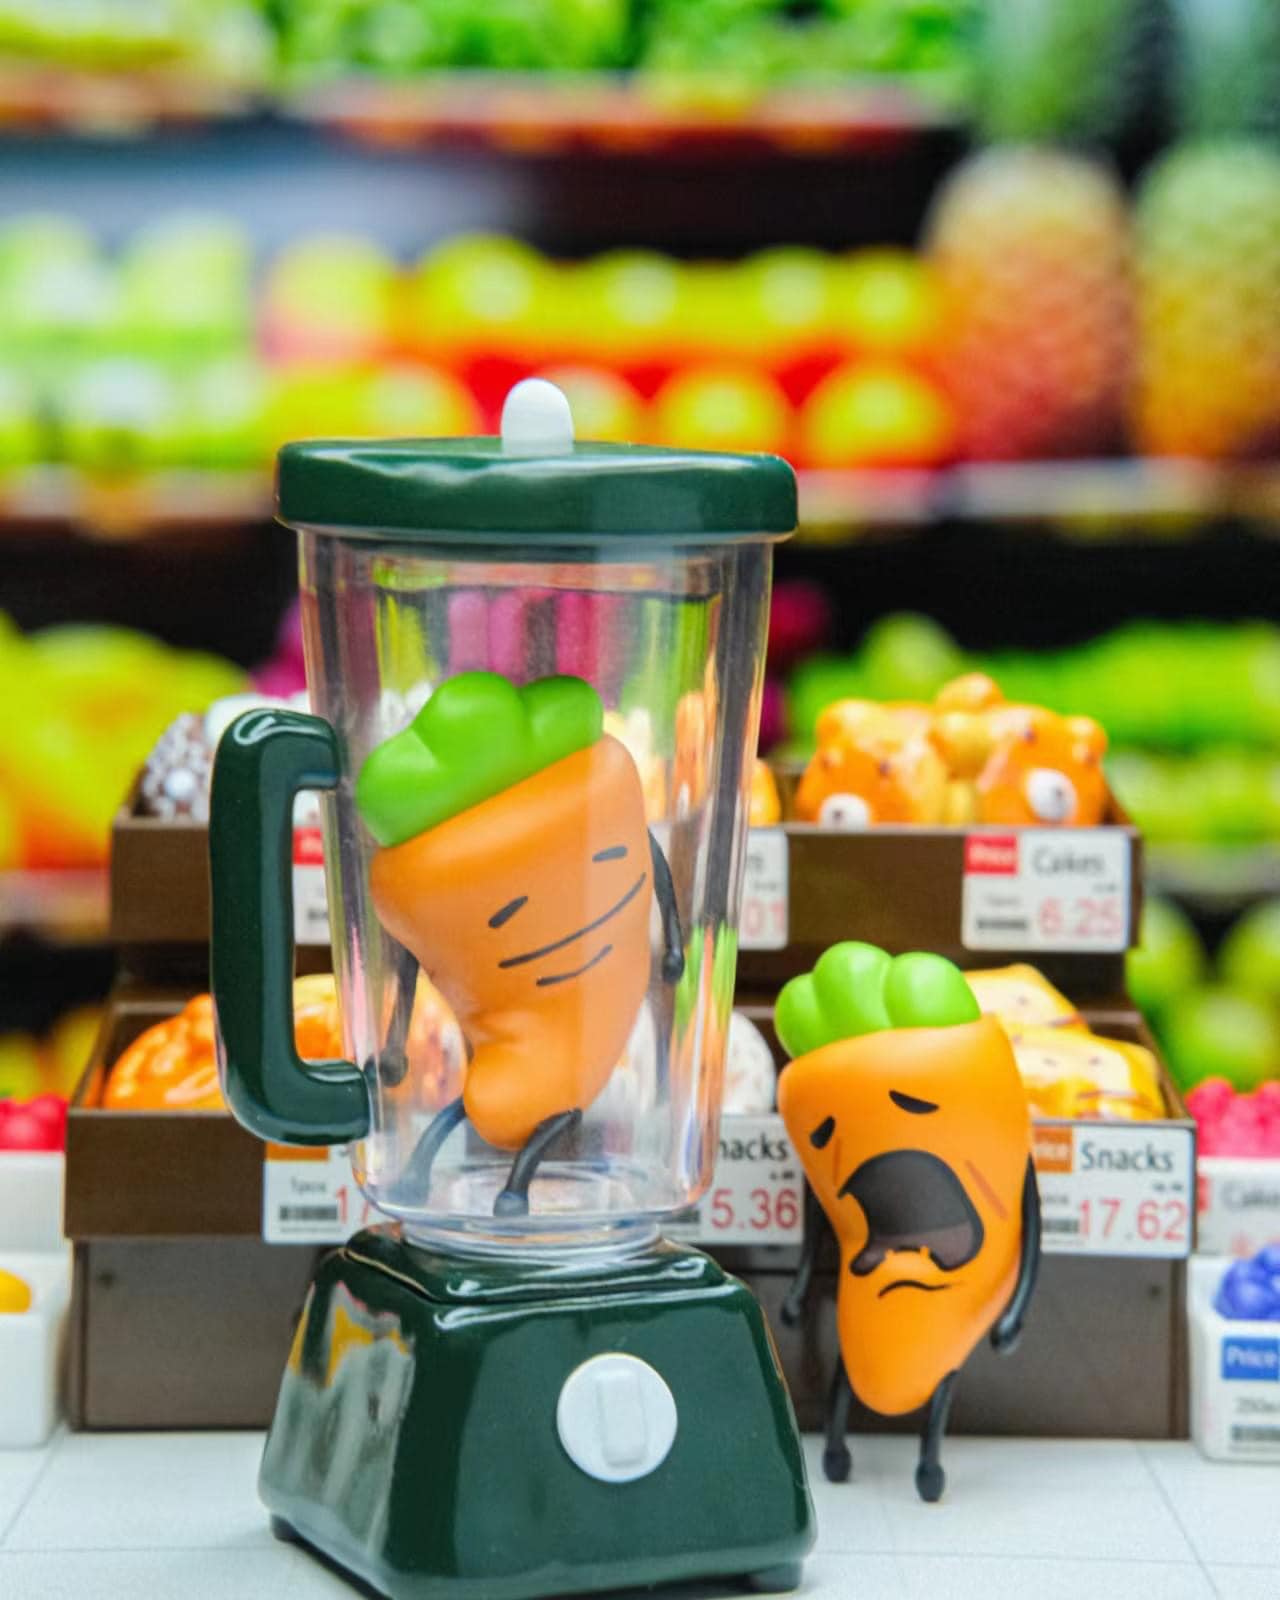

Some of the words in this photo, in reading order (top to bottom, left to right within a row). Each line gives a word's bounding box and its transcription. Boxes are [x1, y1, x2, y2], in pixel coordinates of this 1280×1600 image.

[1033, 845, 1106, 876] Cakes
[1039, 897, 1122, 938] 6.25
[719, 1132, 788, 1161] nacks
[1079, 1140, 1174, 1172] Snacks
[711, 1187, 798, 1230] 5.36
[1078, 1197, 1188, 1242] 17.62
[1227, 1344, 1278, 1368] Price
